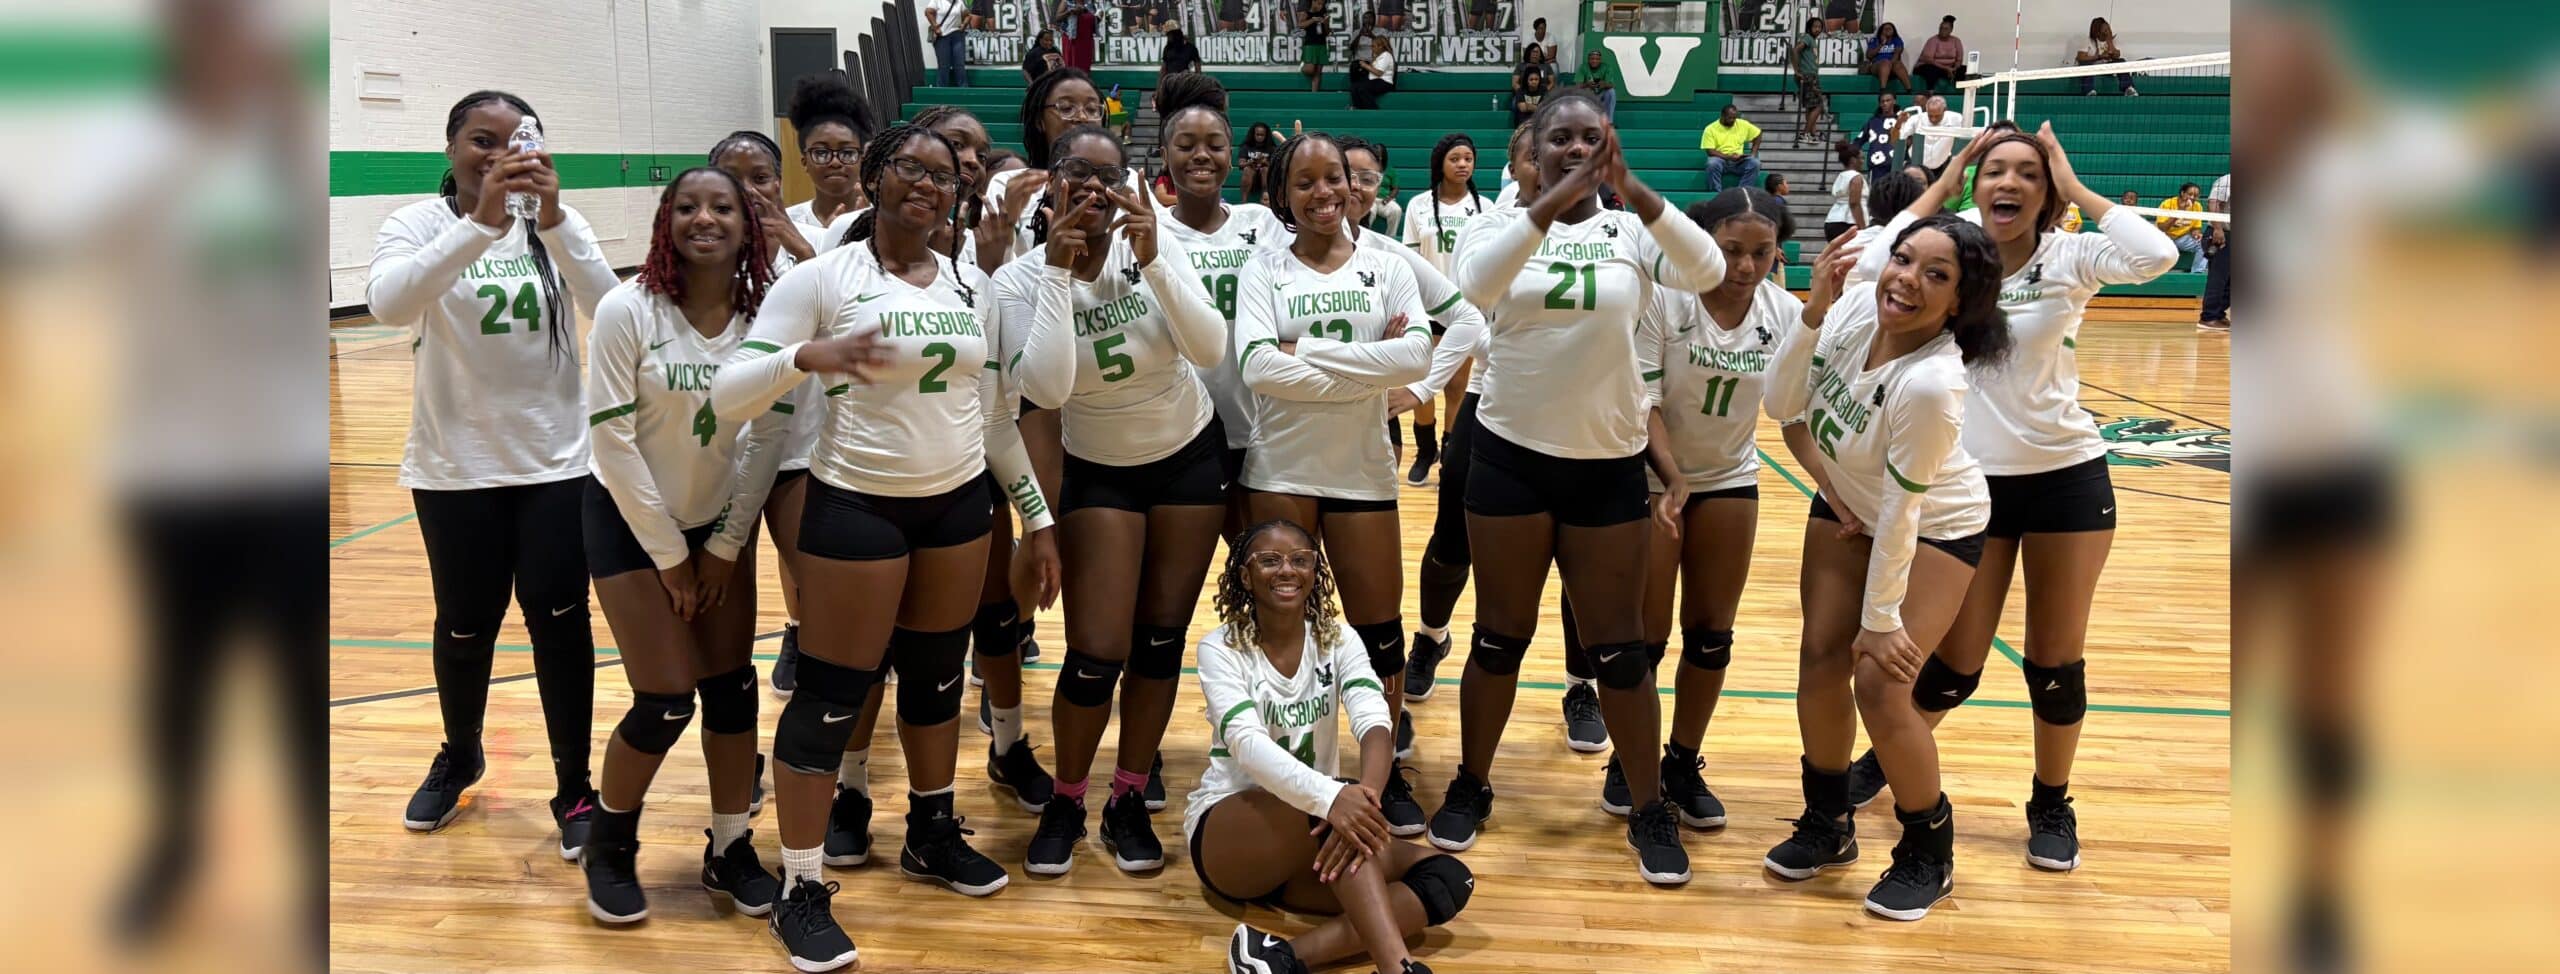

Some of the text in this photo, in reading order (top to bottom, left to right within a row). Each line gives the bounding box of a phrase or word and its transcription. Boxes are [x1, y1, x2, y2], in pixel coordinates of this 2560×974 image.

[994, 4, 1017, 30] 12
[1245, 2, 1260, 29] 4
[1411, 3, 1427, 30] 5
[1497, 3, 1513, 29] 7
[1760, 3, 1791, 31] 24
[965, 36, 1021, 62] EWART
[1272, 36, 1348, 63] GRCE
[1441, 36, 1518, 63] WEST
[1603, 36, 1701, 96] V
[1436, 230, 1457, 253] 16
[1539, 237, 1615, 260] ICKSBURG
[1544, 261, 1597, 311] 21
[476, 282, 541, 335] 24
[1073, 292, 1148, 337] CKSBURG
[1287, 290, 1371, 319] VICKSBURG
[879, 311, 982, 338] VICKSBURG
[919, 342, 957, 394] 2
[1093, 332, 1136, 382] 5
[1688, 343, 1766, 372] VICKSBURG
[1701, 375, 1739, 417] 11
[1816, 364, 1872, 434] VICKSBURG
[692, 398, 717, 448] 4
[1810, 408, 1845, 465] 15
[1007, 474, 1047, 520] 3701
[1263, 693, 1330, 729] VICKSBURG
